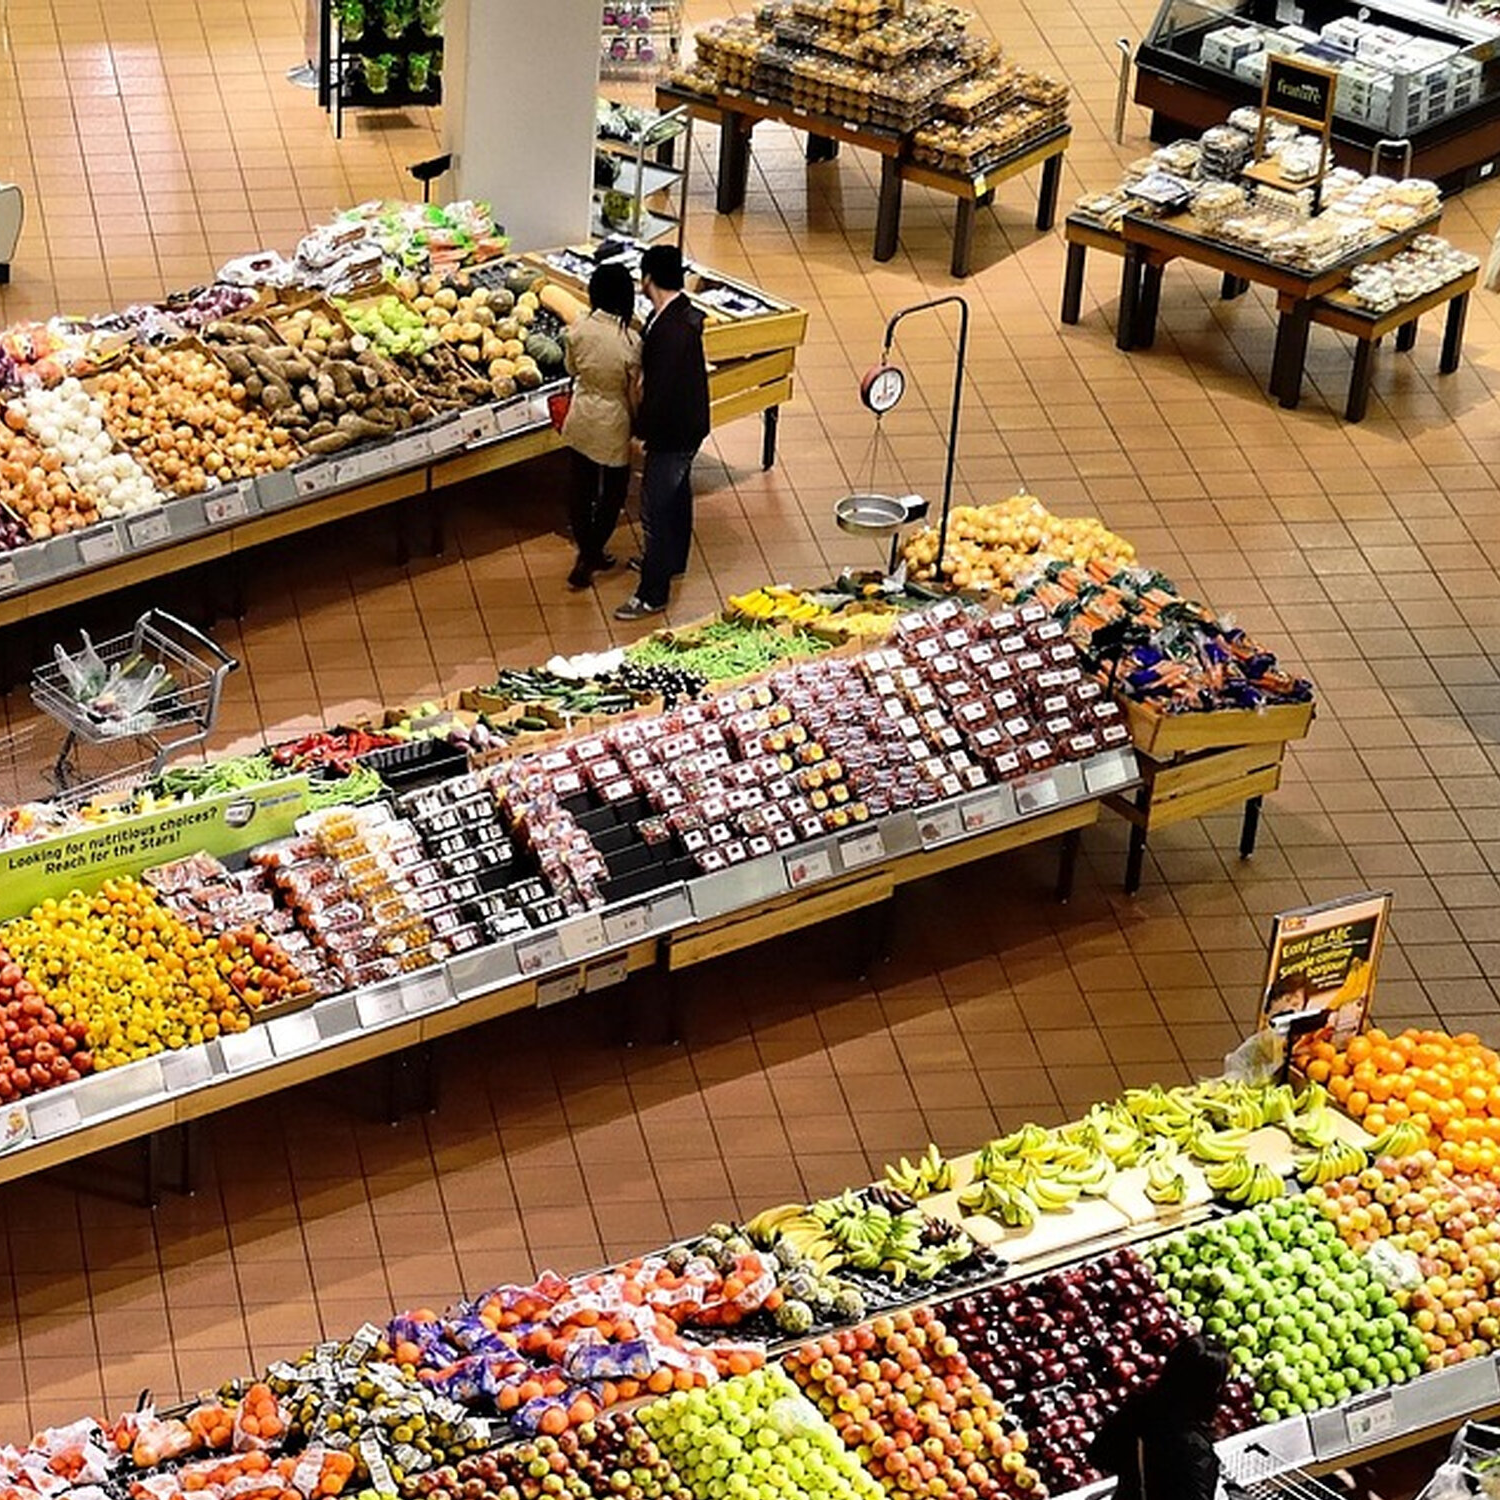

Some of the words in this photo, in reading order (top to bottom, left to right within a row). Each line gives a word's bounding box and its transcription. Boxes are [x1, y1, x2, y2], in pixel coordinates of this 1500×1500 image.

[8, 847, 62, 870] Looking
[66, 842, 85, 855] for
[89, 825, 156, 850] nutritious
[160, 806, 218, 831] choices?
[45, 854, 87, 875] Reach
[91, 849, 110, 863] for
[114, 844, 136, 857] the
[140, 830, 181, 850] Stars!
[1282, 940, 1311, 959] Easy
